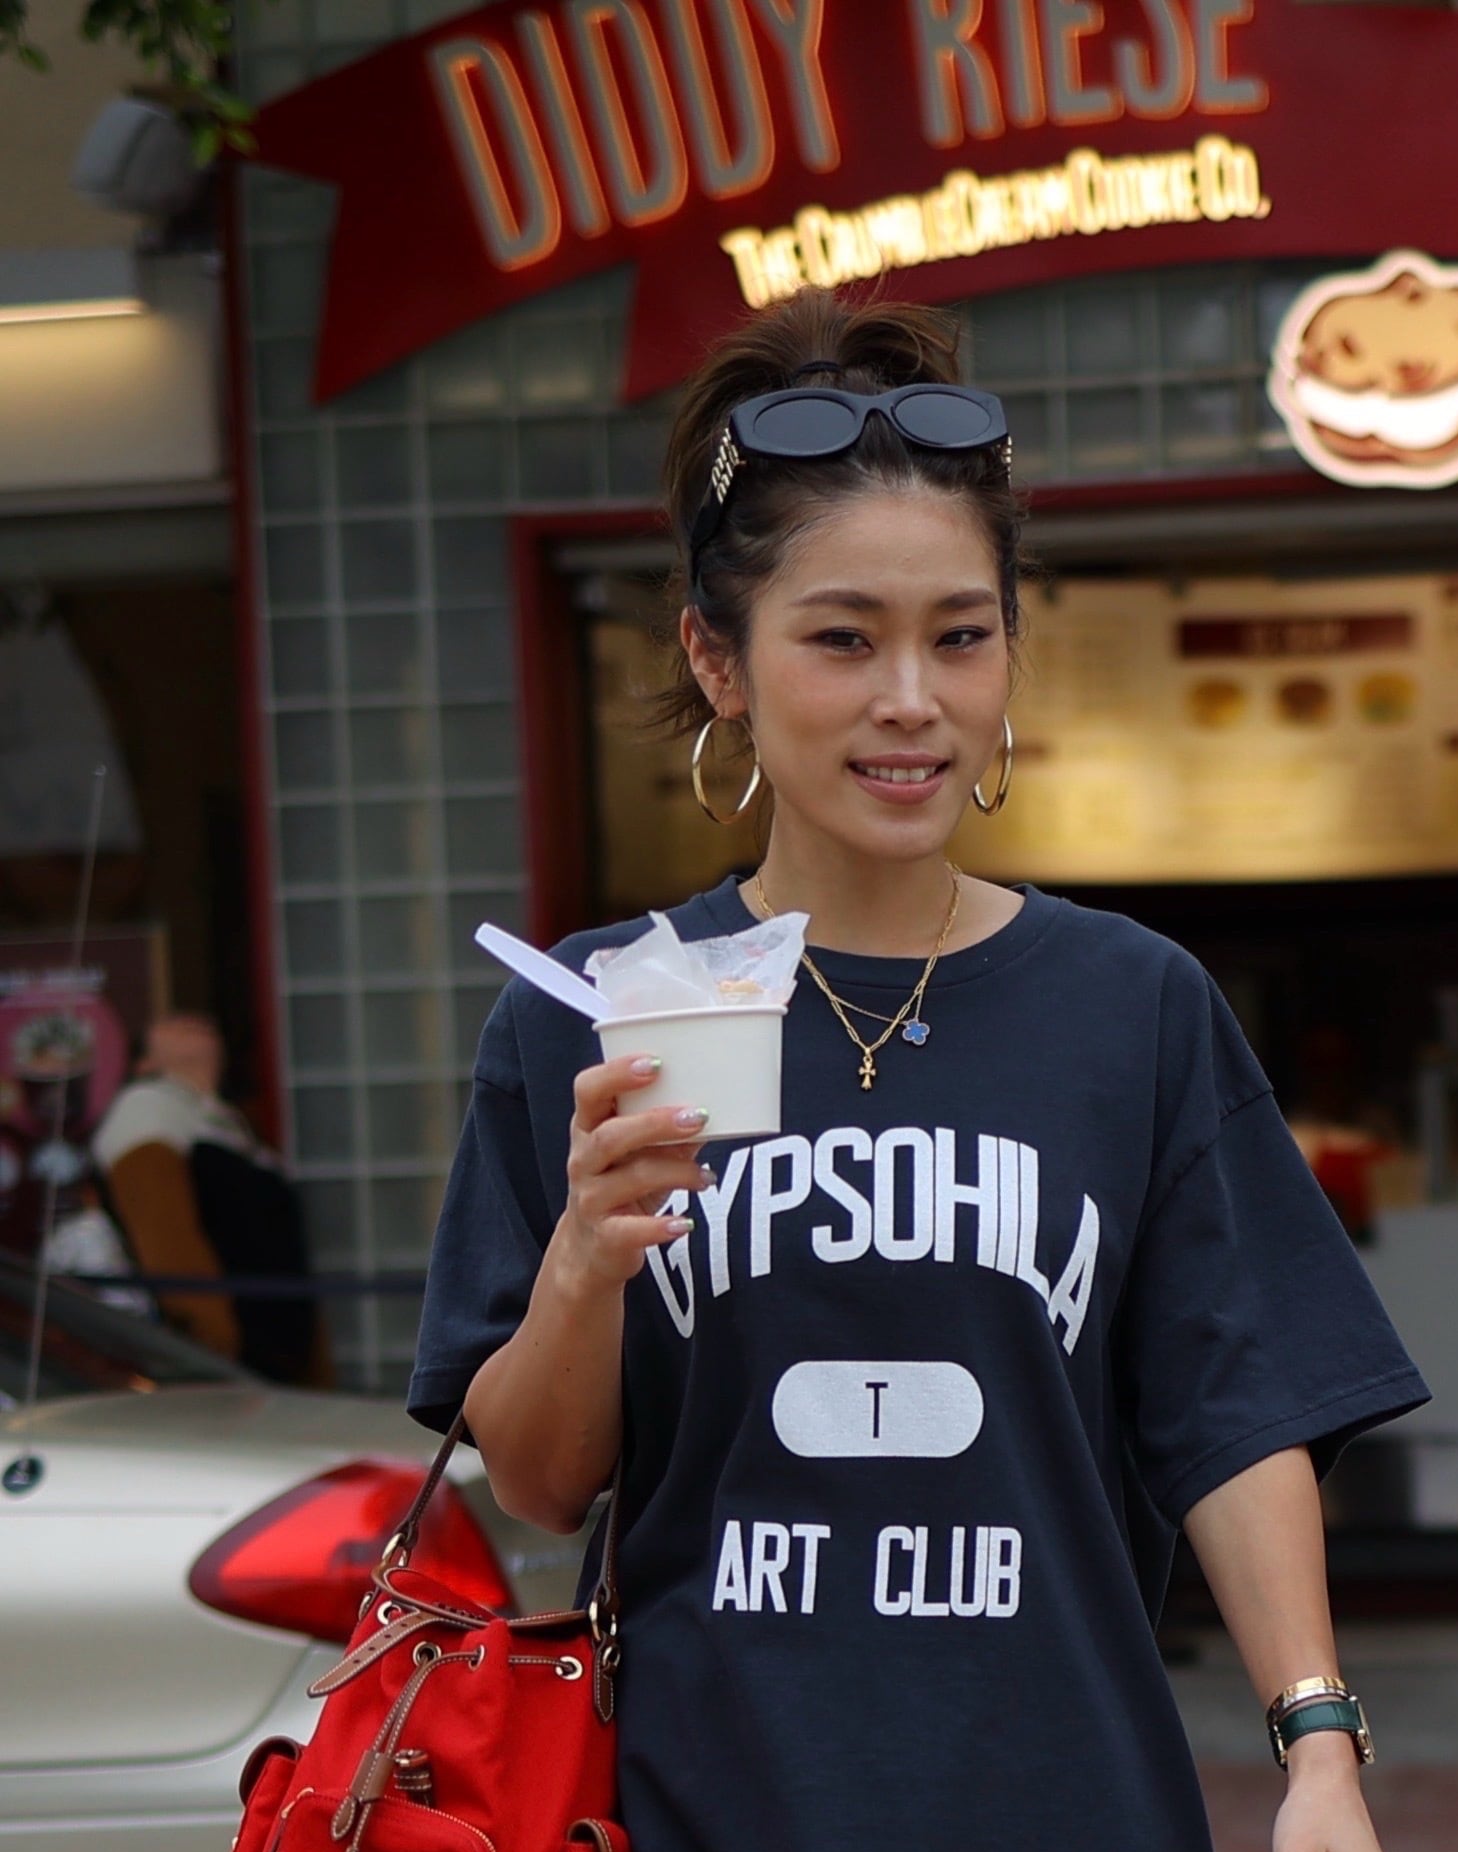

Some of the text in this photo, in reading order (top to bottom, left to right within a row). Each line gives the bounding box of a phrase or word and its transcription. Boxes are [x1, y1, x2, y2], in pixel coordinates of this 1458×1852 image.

[431, 0, 1269, 271] DIDDY RIESE
[645, 1126, 1100, 1356] GYPSOHILA
[865, 1381, 888, 1439] T
[712, 1519, 1022, 1618] ART CLUB
